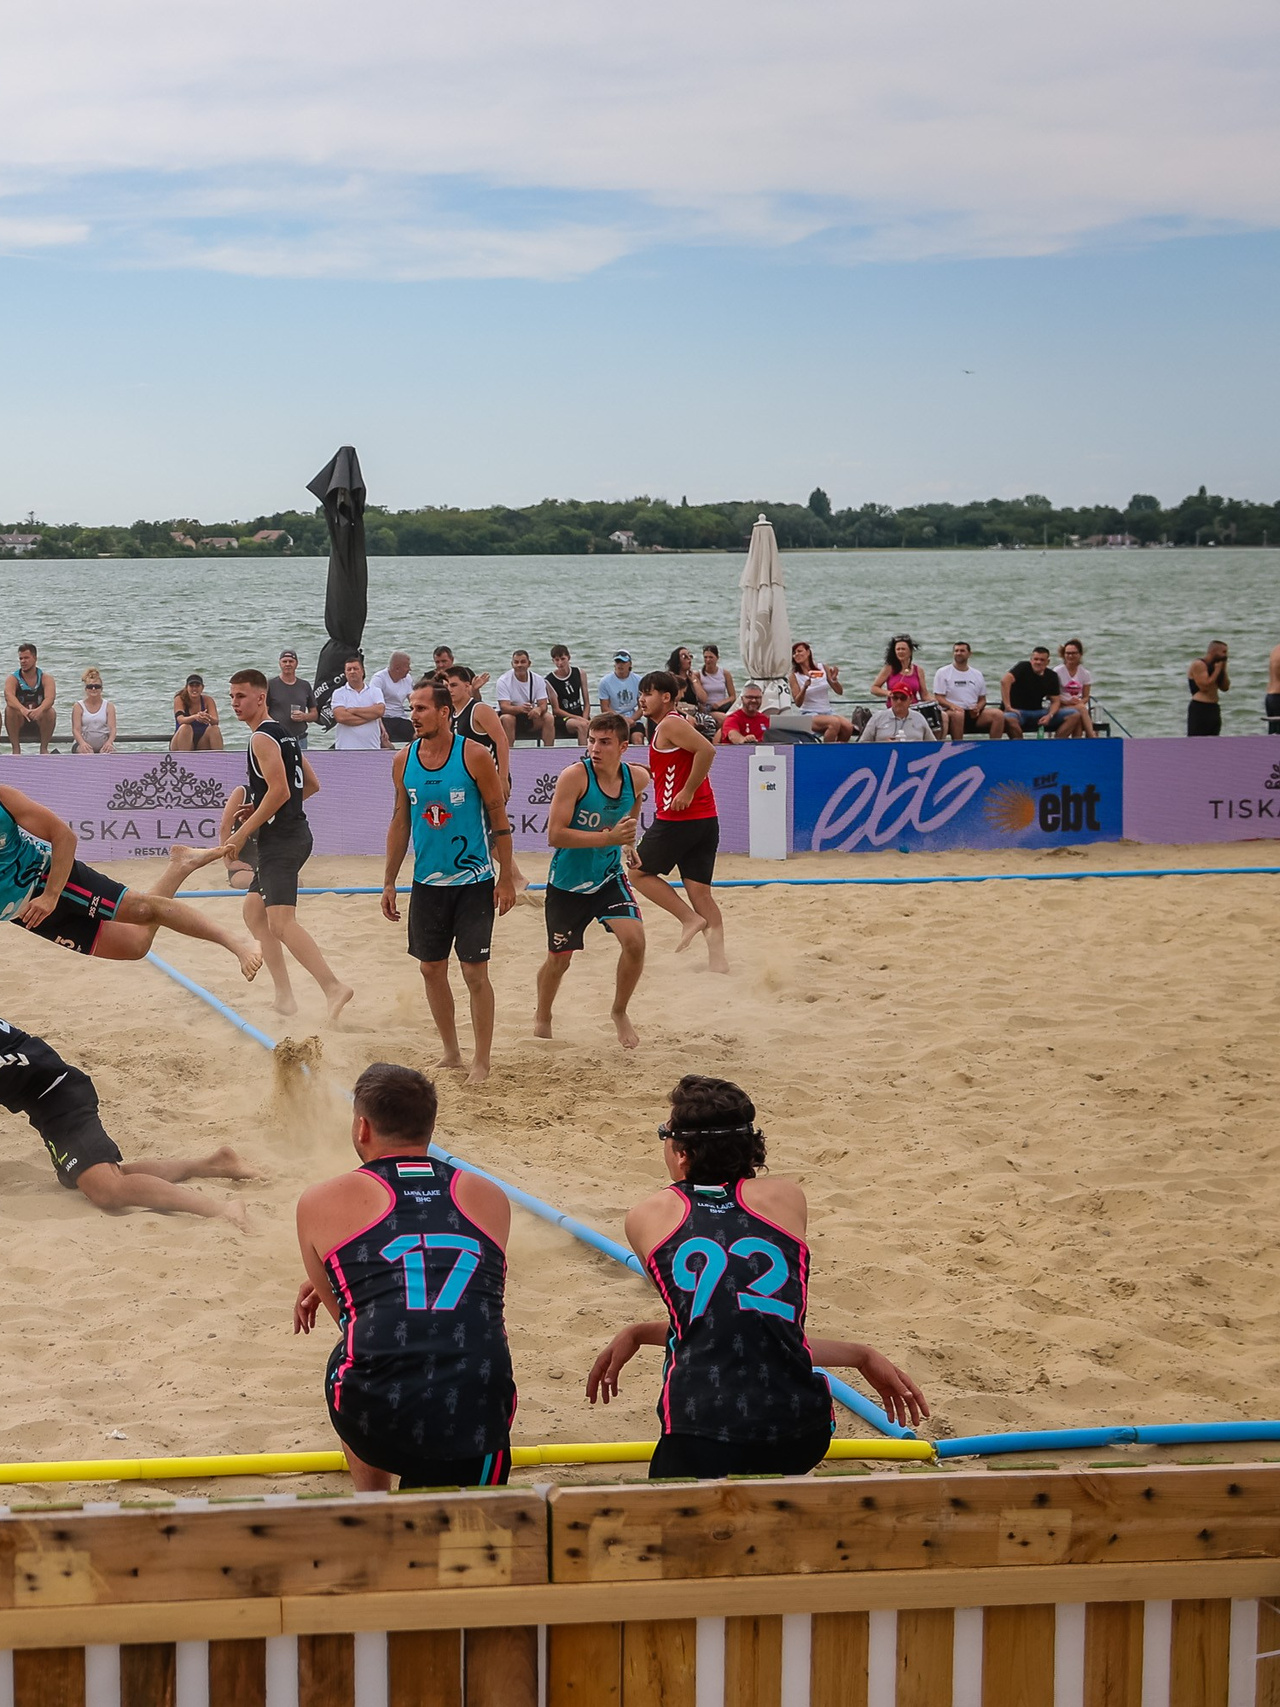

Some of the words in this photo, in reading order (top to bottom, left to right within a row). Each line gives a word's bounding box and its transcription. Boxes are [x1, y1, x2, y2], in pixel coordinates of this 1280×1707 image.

[576, 810, 601, 828] 50
[1039, 785, 1100, 832] ebt
[1208, 799, 1280, 819] TISK
[65, 1157, 78, 1172] JAKO
[379, 1234, 481, 1310] 17
[671, 1236, 795, 1325] 92
